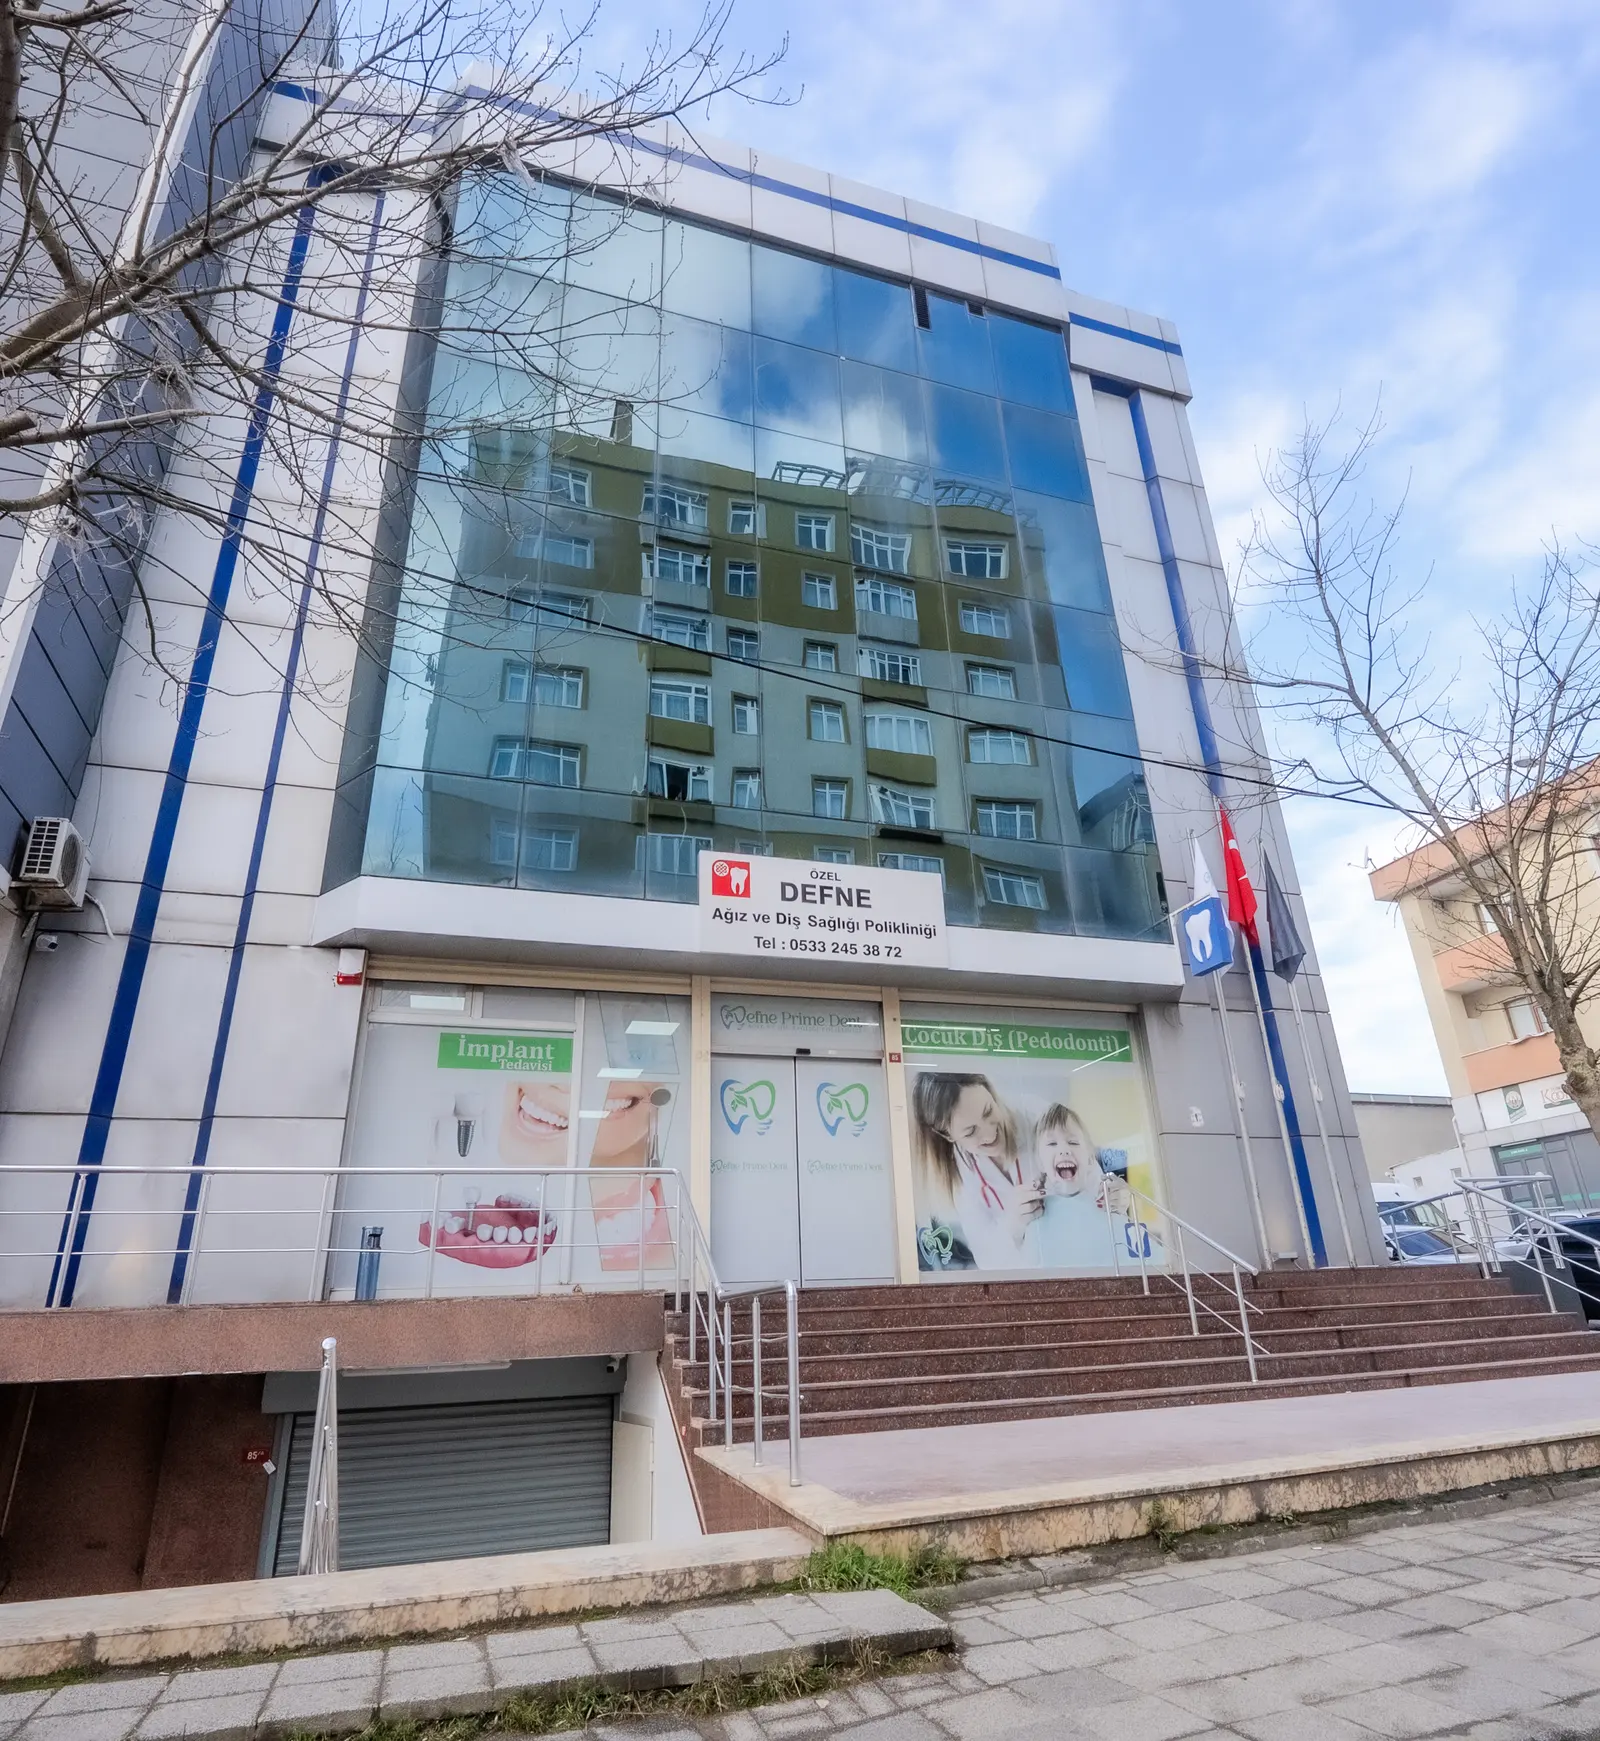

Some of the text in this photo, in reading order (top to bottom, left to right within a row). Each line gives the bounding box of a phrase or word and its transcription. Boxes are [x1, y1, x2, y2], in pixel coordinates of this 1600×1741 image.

[810, 868, 841, 882] ÖZEL
[780, 881, 872, 908] DEFNE
[712, 907, 937, 939] Ağız ve Diş Sağlığı Polikliniği
[754, 936, 776, 949] Tel
[790, 939, 826, 953] 0533
[831, 942, 858, 955] 245
[862, 944, 880, 957] 38
[884, 945, 902, 958] 72
[781, 1011, 825, 1024] Prime
[457, 1034, 555, 1063] İmplant
[904, 1026, 1119, 1055] Çocuk Diş (Pedodonti)
[498, 1058, 553, 1071] Tedavisi
